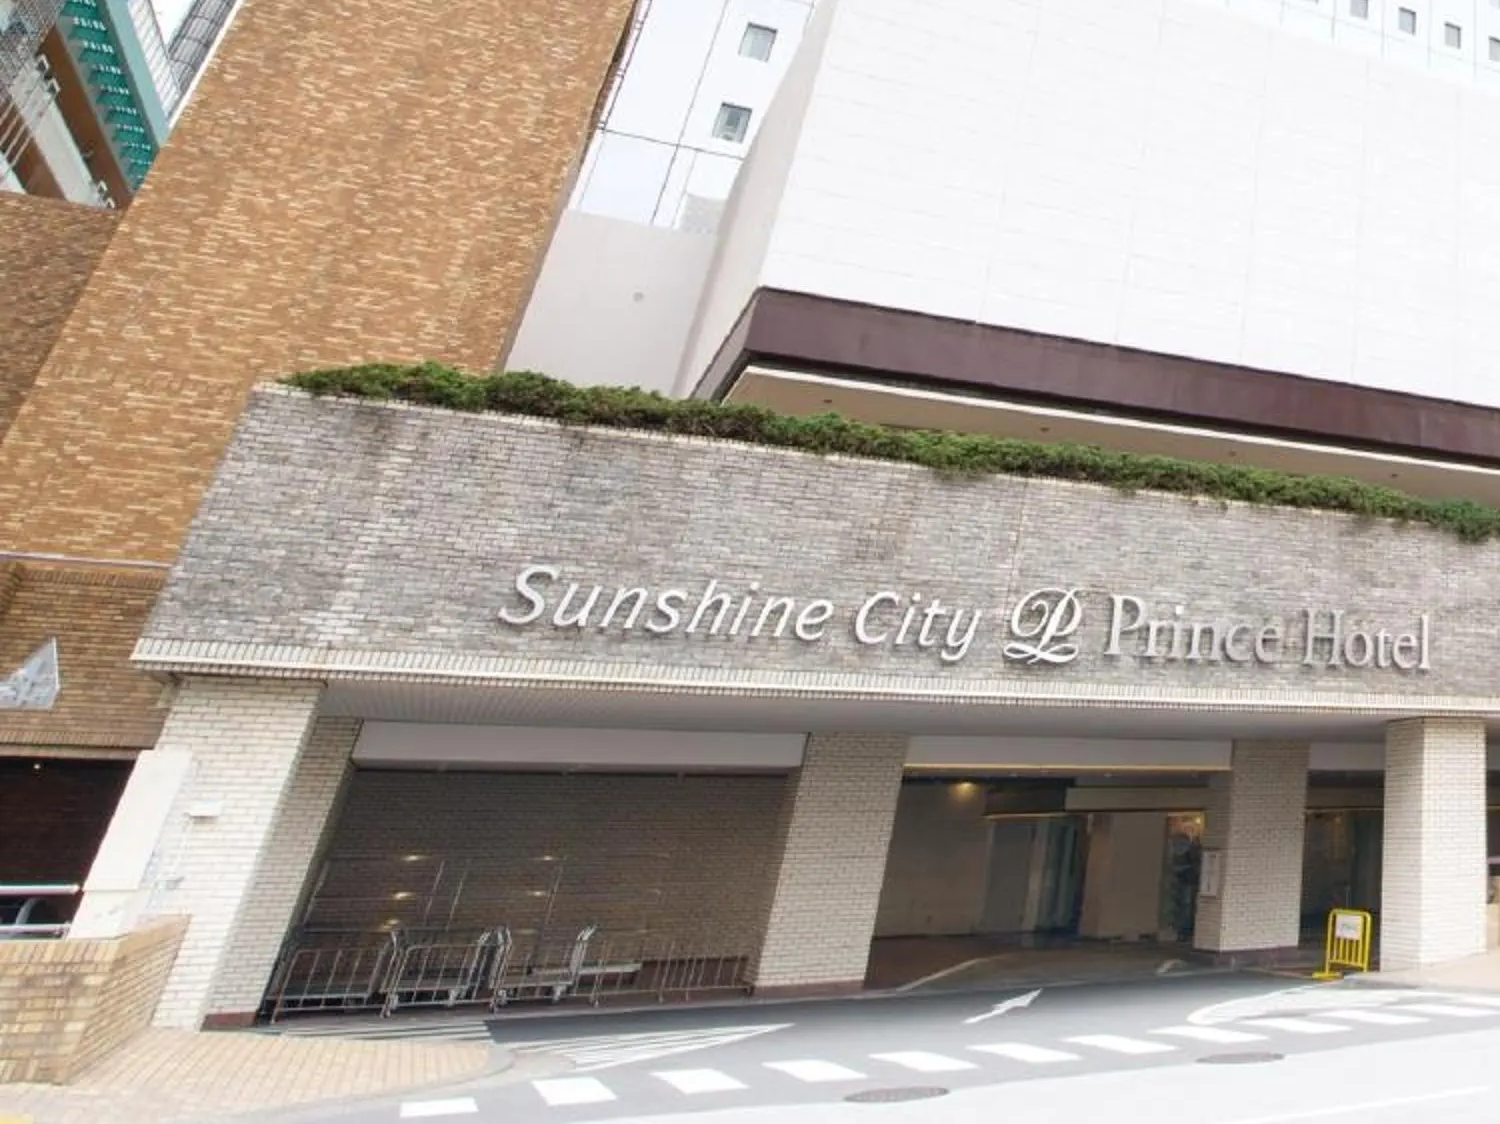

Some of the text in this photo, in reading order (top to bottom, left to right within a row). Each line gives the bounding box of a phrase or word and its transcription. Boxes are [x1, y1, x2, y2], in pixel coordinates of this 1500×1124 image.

[499, 564, 835, 641] Sunshine
[854, 591, 983, 663] City
[1103, 594, 1283, 664] Prince
[1302, 607, 1432, 671] Hotel
